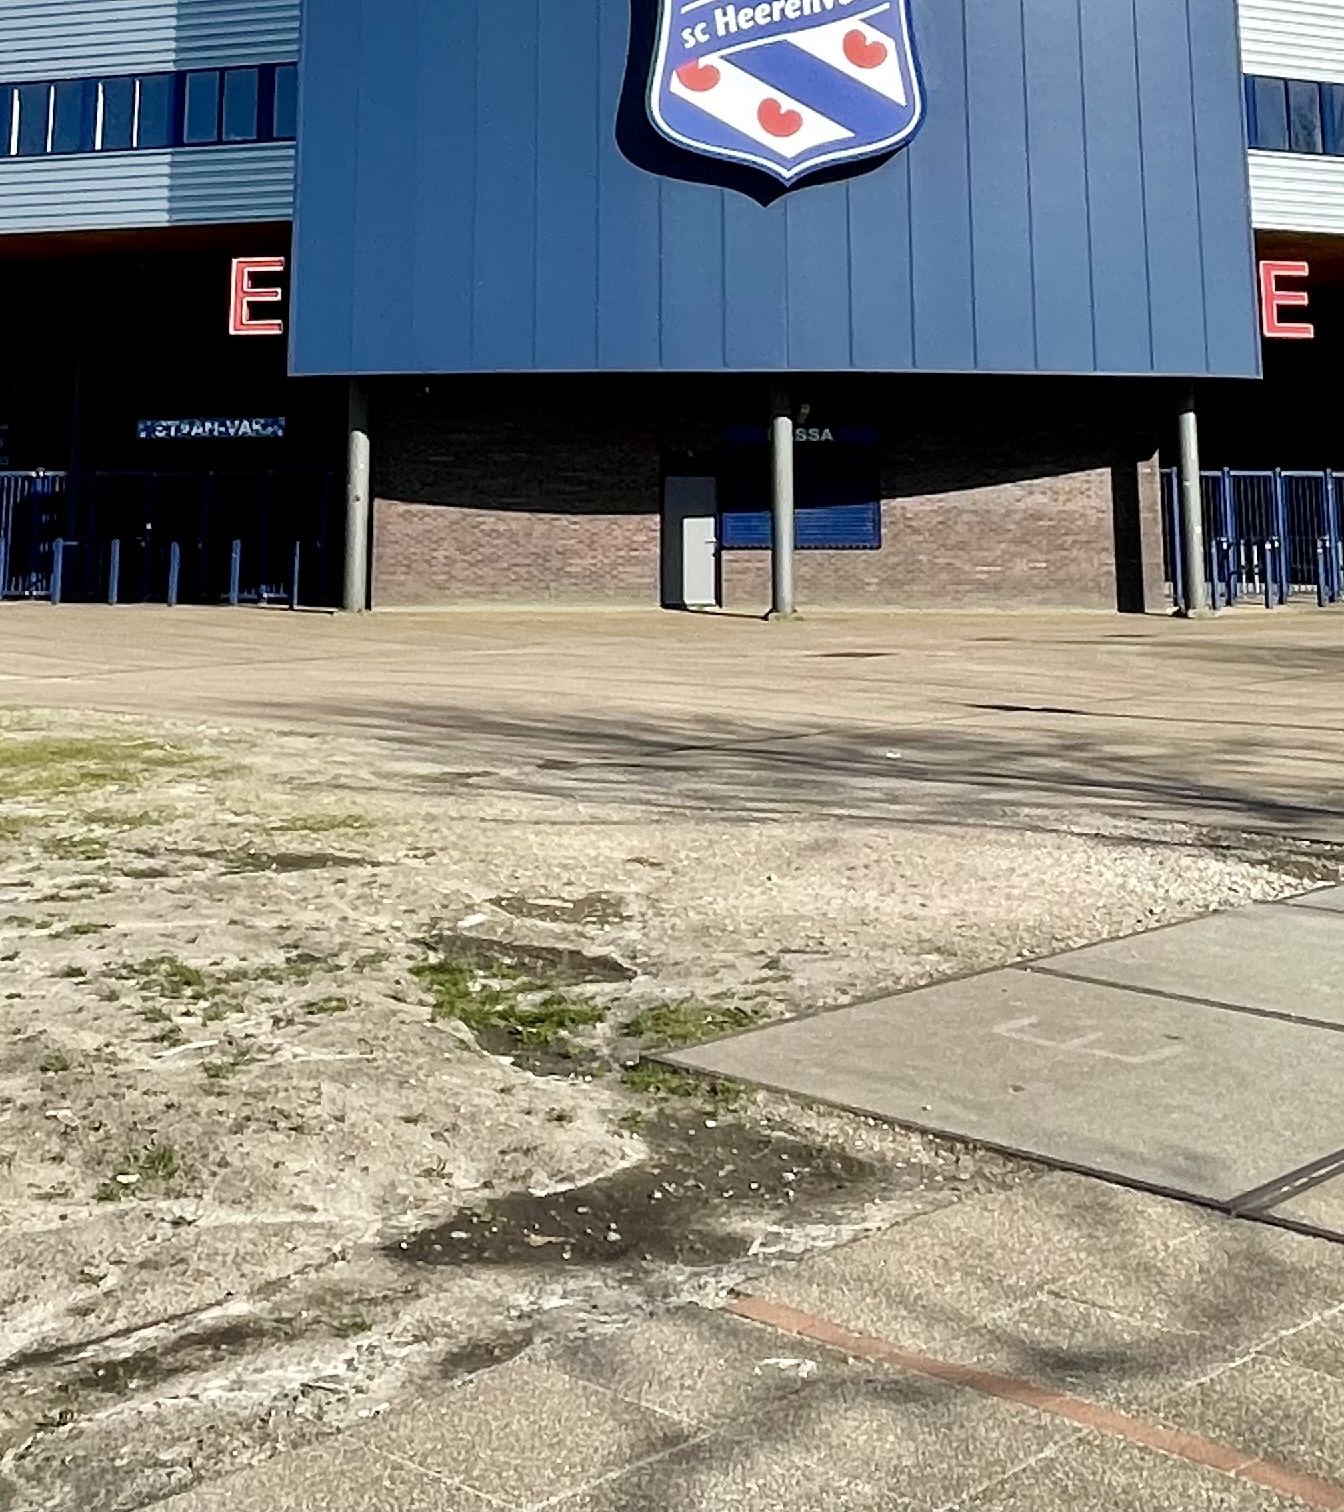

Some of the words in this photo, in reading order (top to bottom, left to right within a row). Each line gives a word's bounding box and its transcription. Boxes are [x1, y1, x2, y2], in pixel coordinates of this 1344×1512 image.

[680, 23, 710, 50] sc
[228, 256, 285, 336] E
[1258, 260, 1315, 339] E
